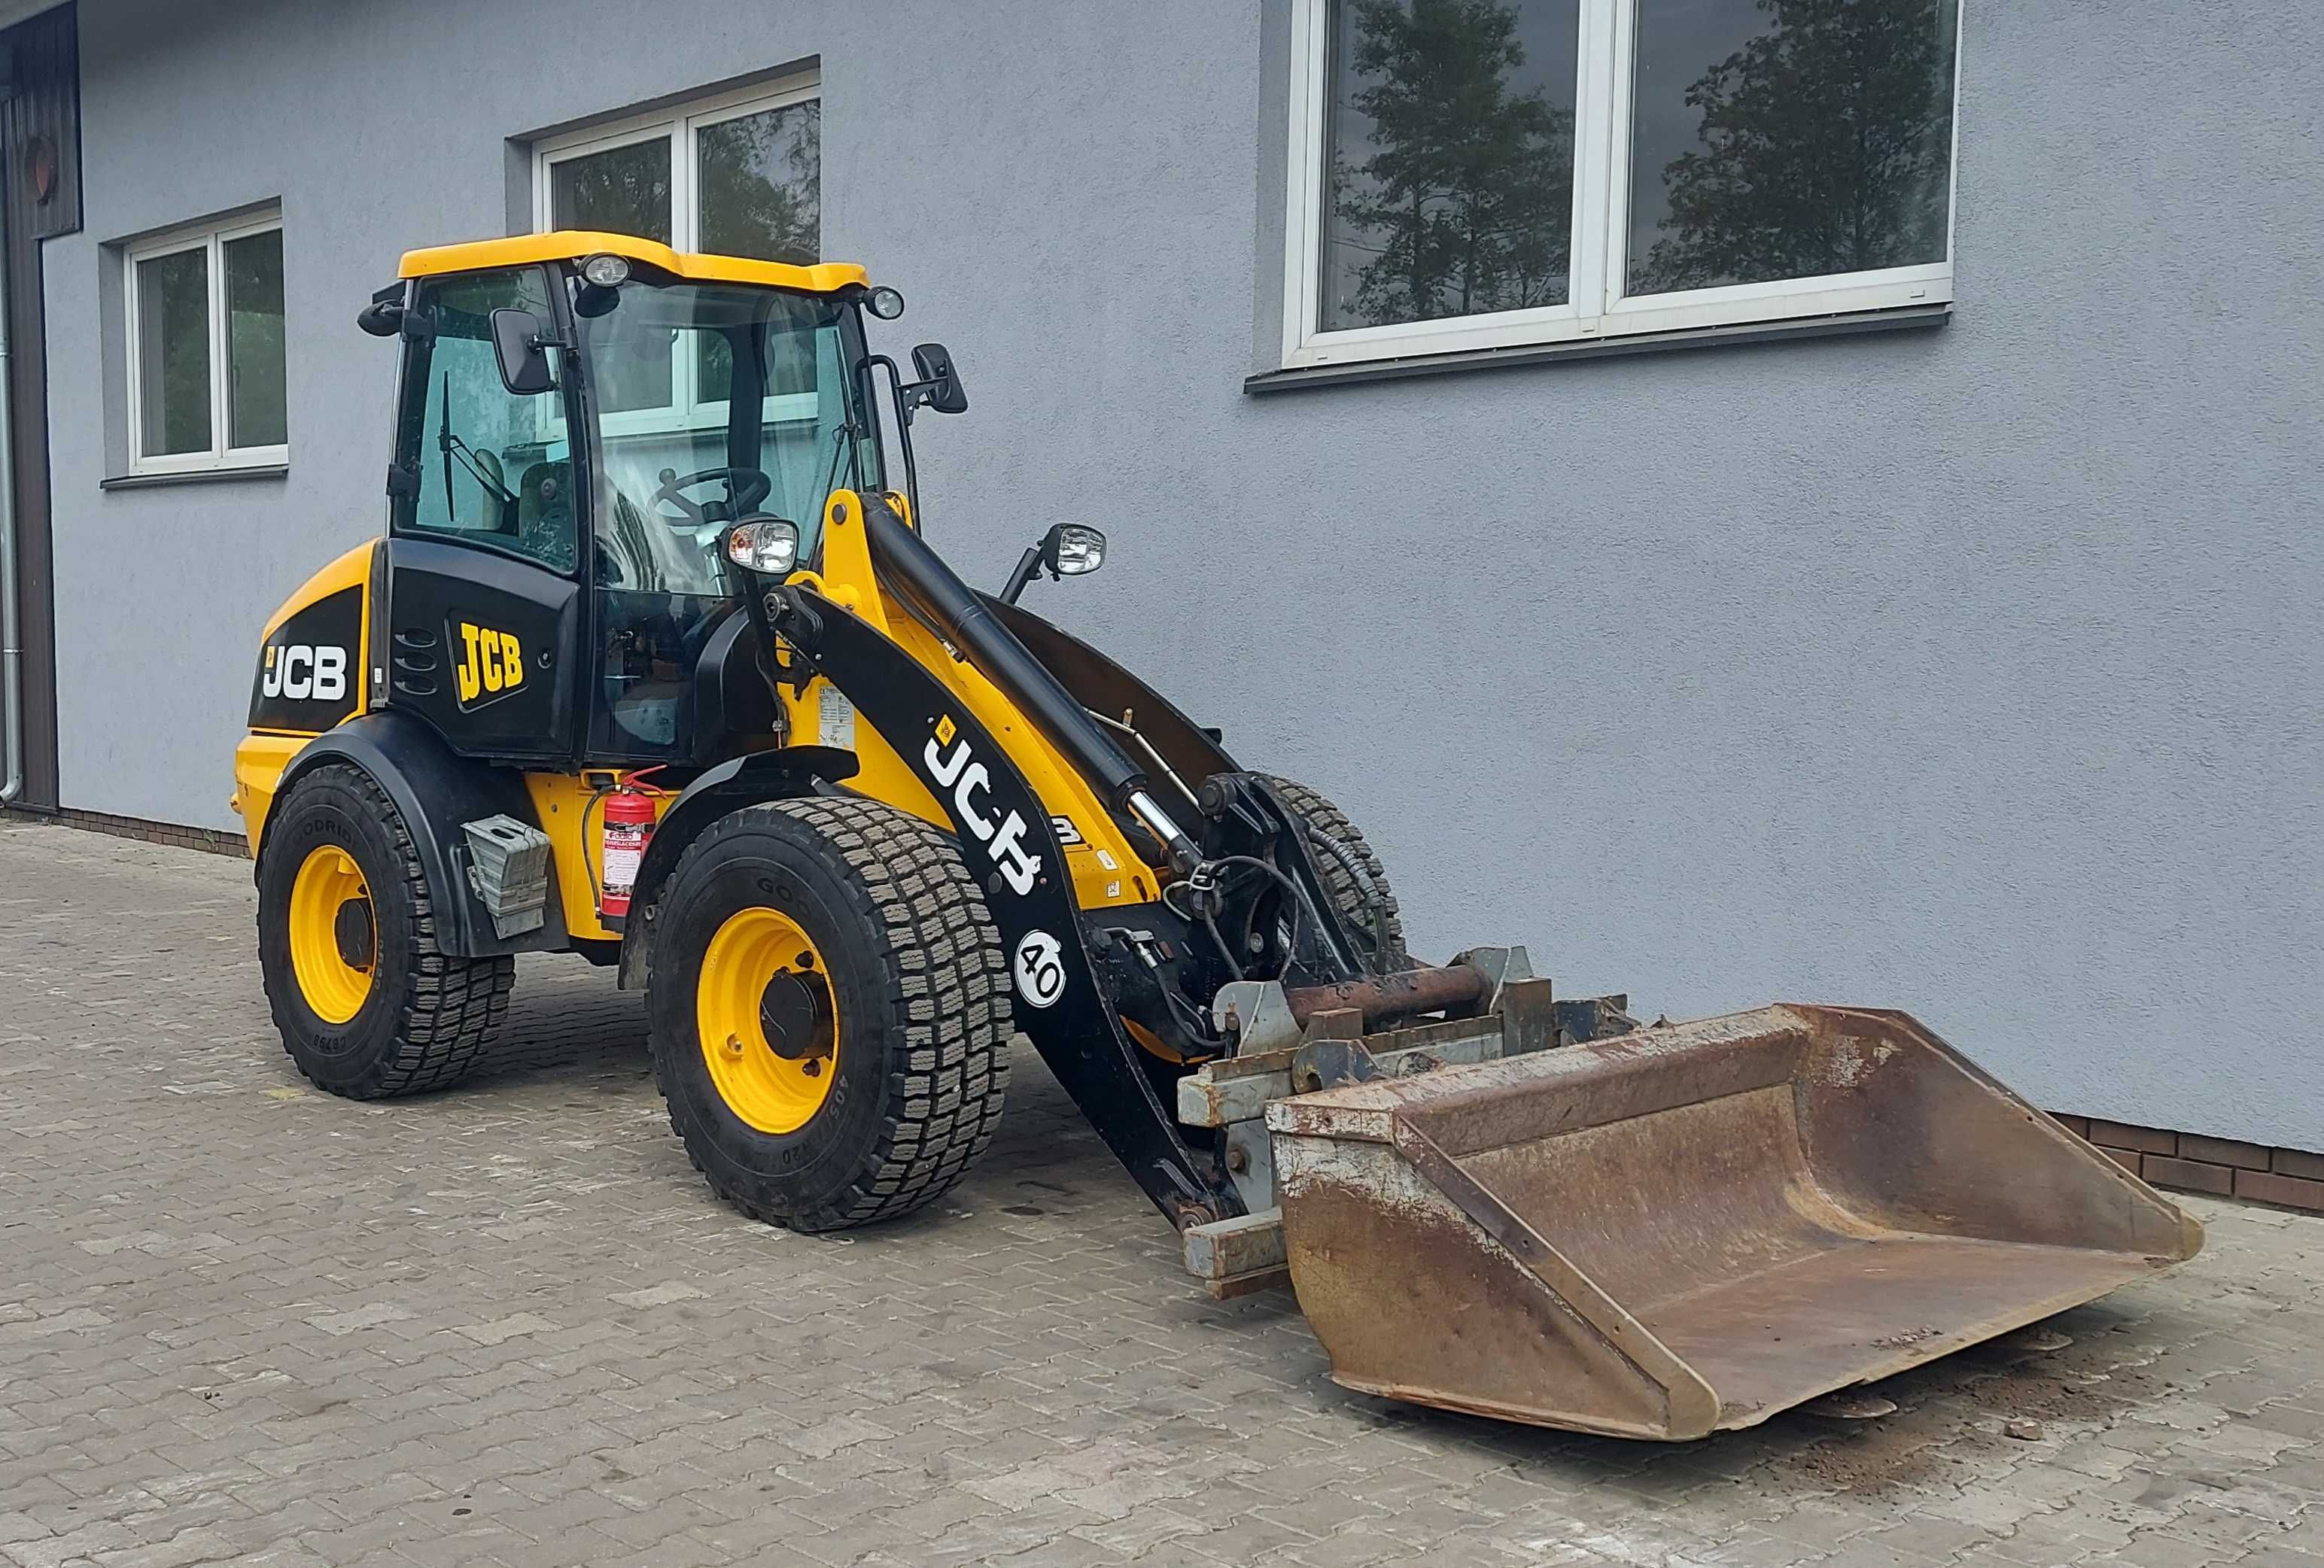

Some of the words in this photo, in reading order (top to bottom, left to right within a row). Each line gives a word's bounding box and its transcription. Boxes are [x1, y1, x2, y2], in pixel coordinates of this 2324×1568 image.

[263, 645, 346, 700] JCB
[458, 623, 523, 702] JCB
[1021, 944, 1060, 998] 40
